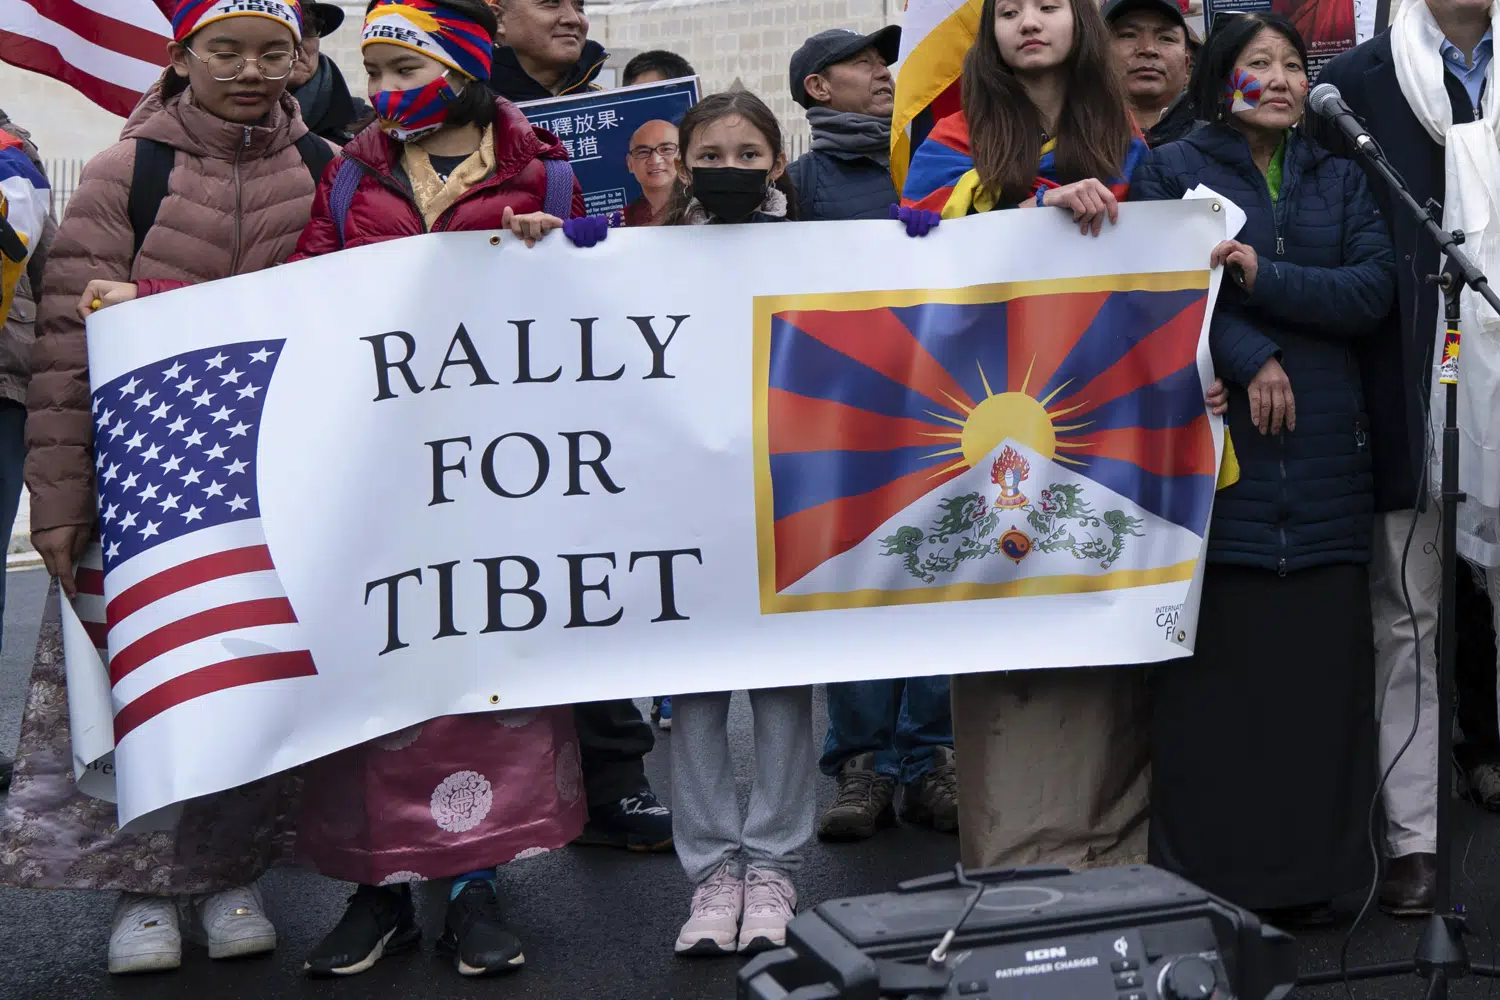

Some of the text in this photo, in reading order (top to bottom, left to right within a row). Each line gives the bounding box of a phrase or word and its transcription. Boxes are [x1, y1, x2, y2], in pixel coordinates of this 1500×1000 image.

[218, 4, 294, 21] TIBET
[364, 30, 430, 47] TIBET
[371, 24, 418, 37] FREE
[360, 314, 691, 402] RALLY
[424, 430, 626, 507] FOR
[364, 547, 703, 656] TIBET
[995, 957, 1099, 979] PATHFINDER CHARGER
